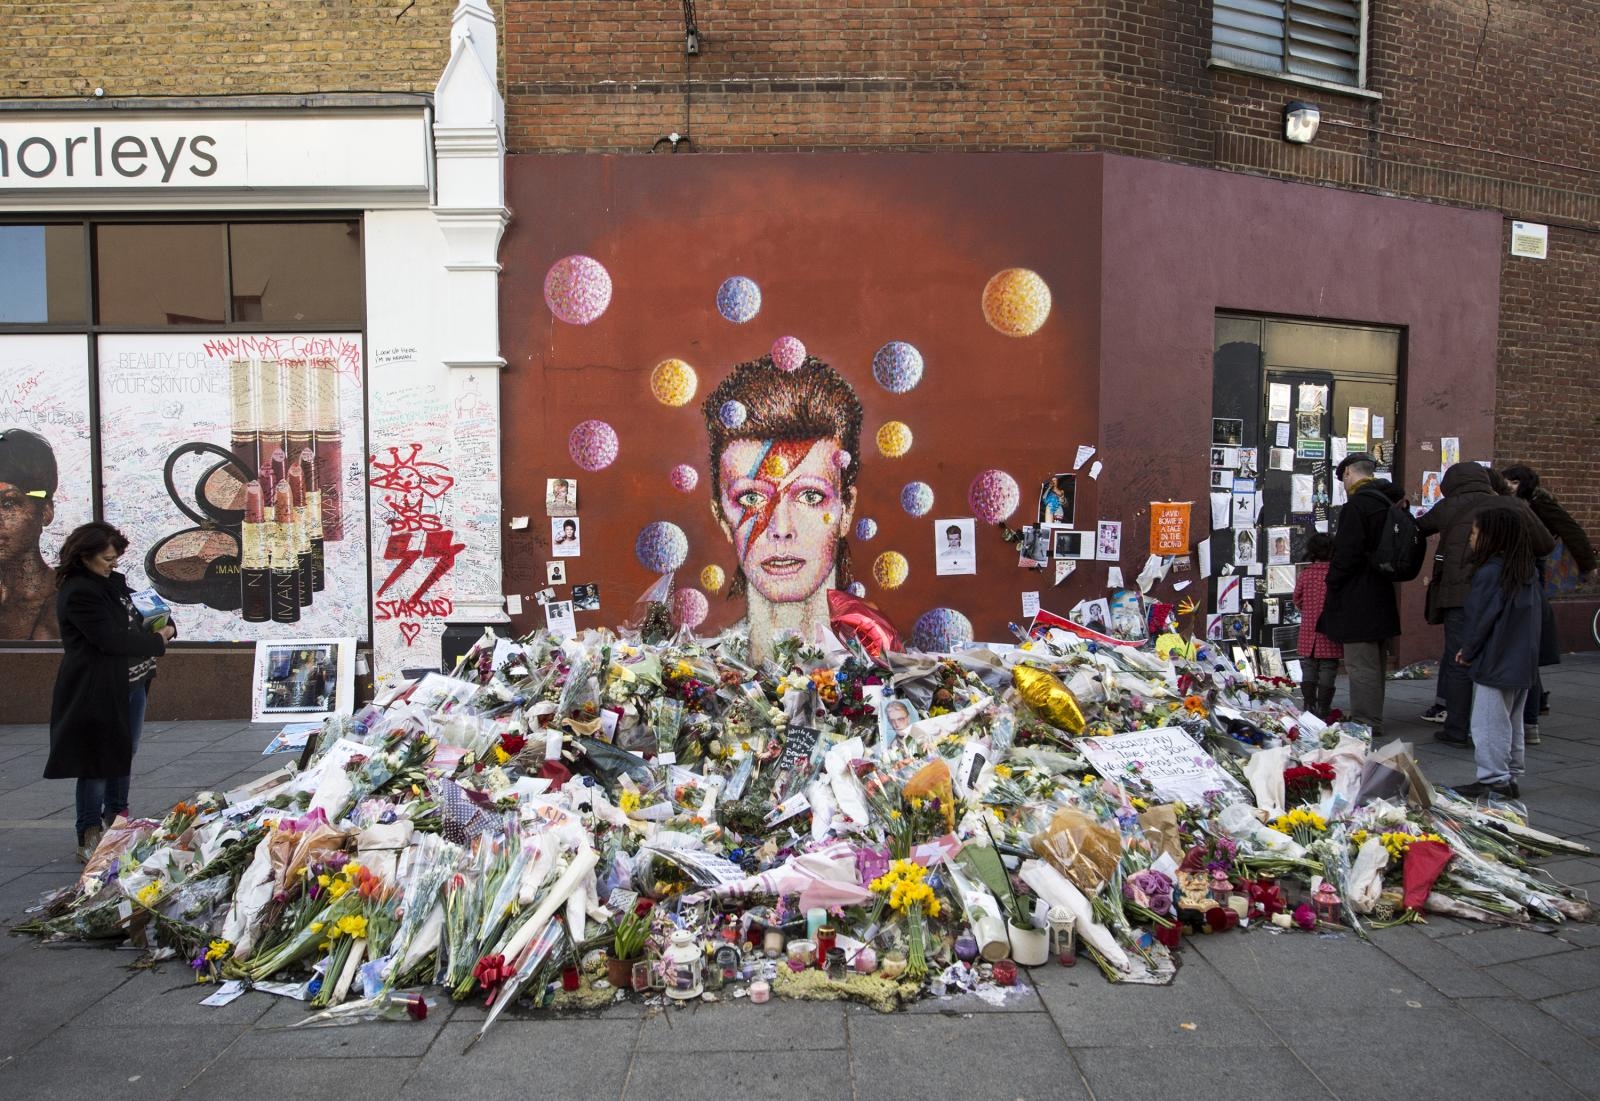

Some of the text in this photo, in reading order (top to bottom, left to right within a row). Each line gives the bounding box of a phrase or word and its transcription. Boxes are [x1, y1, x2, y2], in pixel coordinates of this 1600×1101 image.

[0, 127, 218, 183] orleys
[119, 352, 208, 369] BEAUTY FOR
[107, 377, 146, 393] YOUR
[322, 484, 337, 529] IMAN
[1160, 540, 1182, 548] CROWD
[277, 573, 293, 620] IMAN
[544, 806, 567, 823] RIP
